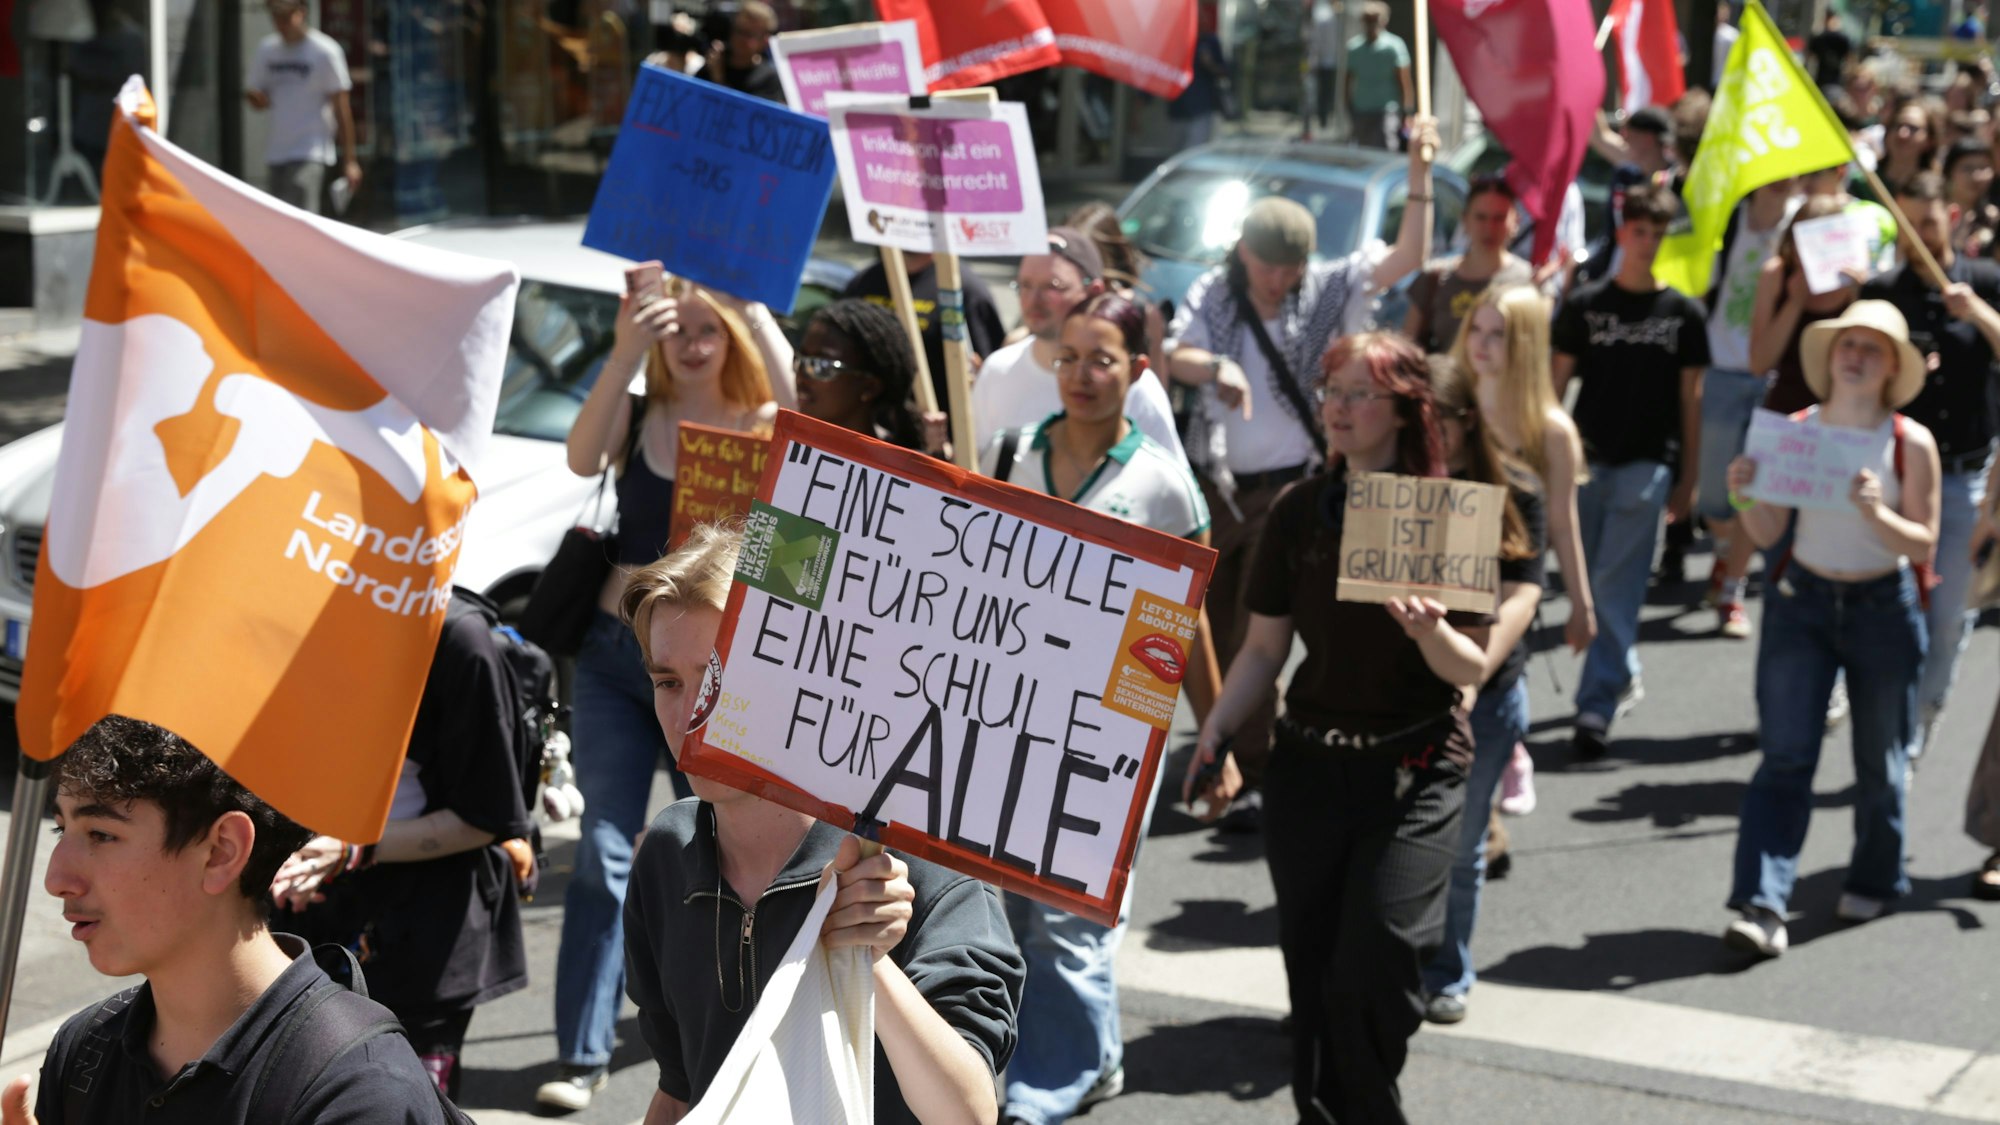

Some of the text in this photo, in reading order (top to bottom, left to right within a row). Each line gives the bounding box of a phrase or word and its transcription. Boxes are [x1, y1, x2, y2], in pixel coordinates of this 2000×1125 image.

[798, 69, 833, 86] Mehr
[638, 77, 682, 133] FIX
[695, 95, 743, 148] THE
[861, 134, 1001, 160] Inklusion ist ein
[866, 163, 1009, 191] Menschenrecht
[1348, 480, 1478, 517] BILDUNG
[735, 510, 760, 573] MENTAL
[741, 511, 770, 577] HEALTH
[752, 515, 778, 581] MATTERS
[1392, 517, 1434, 549] IST
[931, 496, 1134, 616] SCHULE
[1346, 548, 1499, 593] GRUNDRECHT
[837, 549, 948, 627] FÜR
[1137, 612, 1177, 633] ABOUT
[1141, 600, 1173, 620] LET'S
[752, 596, 1104, 760] EINE SCHULE
[720, 692, 751, 713] BSV
[716, 710, 748, 737] Kreis
[784, 687, 891, 780] FÜR
[709, 731, 774, 766] Mettmann
